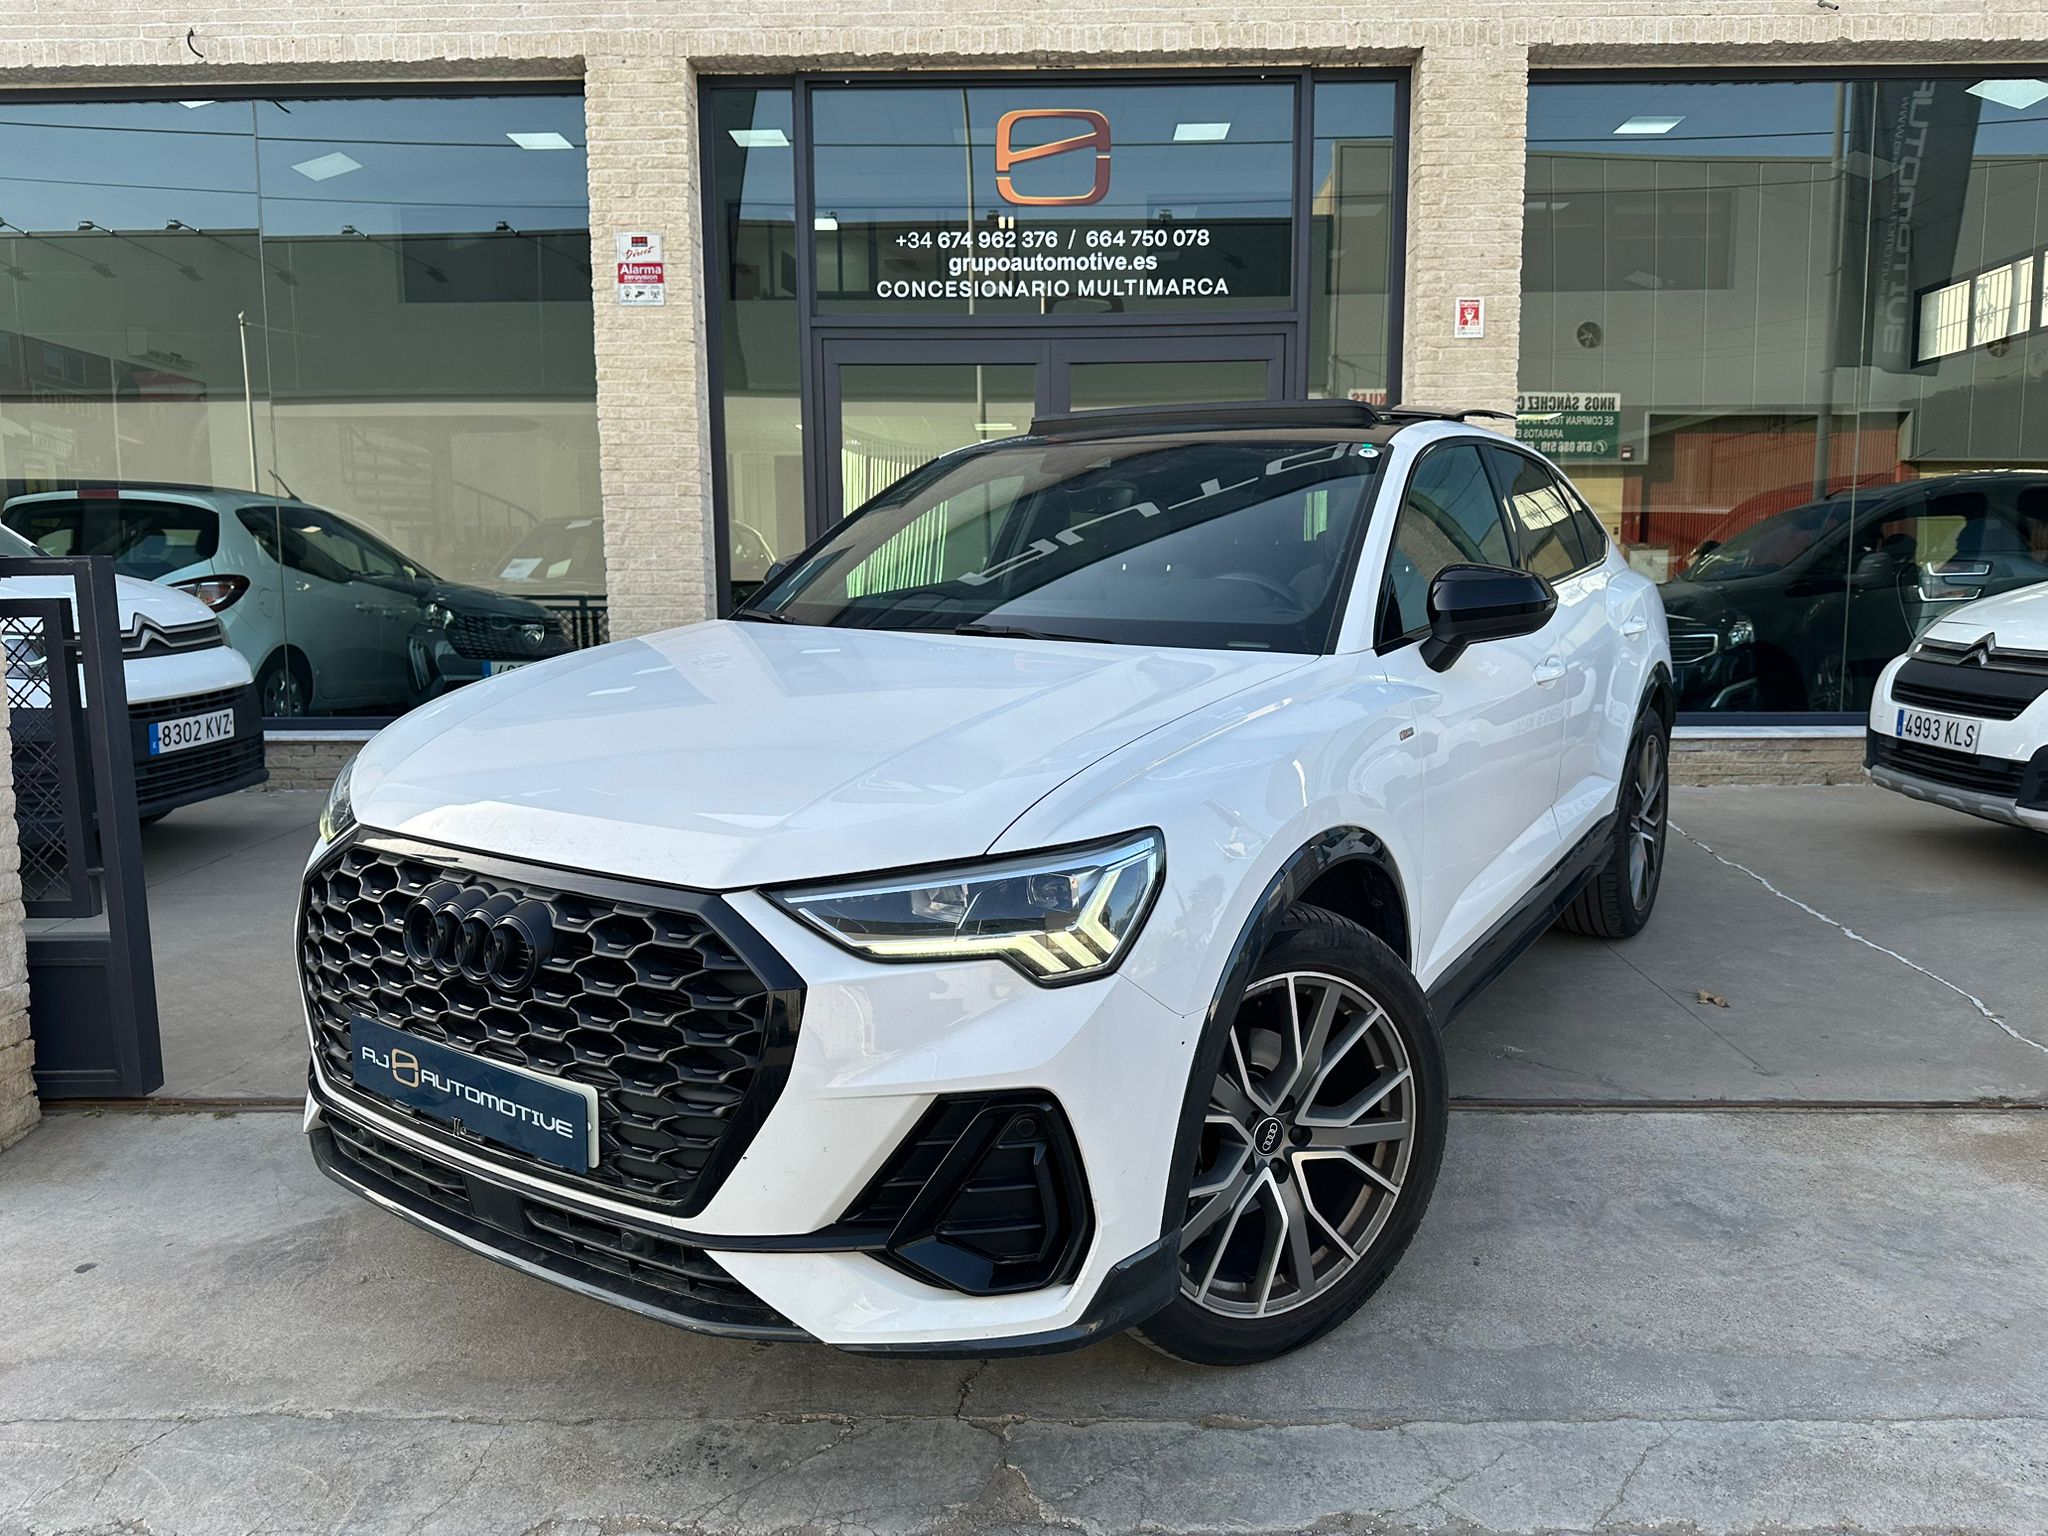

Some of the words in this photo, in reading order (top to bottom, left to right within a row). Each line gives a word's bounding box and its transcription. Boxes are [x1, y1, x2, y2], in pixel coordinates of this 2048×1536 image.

[895, 231, 933, 249] +34
[937, 231, 974, 249] 674
[978, 231, 1017, 249] 962
[1021, 230, 1058, 248] 376
[1085, 229, 1126, 248] 664
[1130, 229, 1168, 247] 750
[1172, 229, 1210, 247] 078
[620, 263, 662, 275] Alarma
[949, 252, 1158, 276] grupoautomotive.es
[876, 279, 1070, 298] CONCESIONARIO
[1077, 277, 1229, 297] MULTIMARCA
[162, 719, 202, 748] 8302
[205, 713, 231, 739] KVZ
[1905, 713, 1941, 741] 4993
[1944, 720, 1975, 748] KLS
[361, 1045, 390, 1069] AJ
[420, 1068, 574, 1139] AUTOMOTIVE
